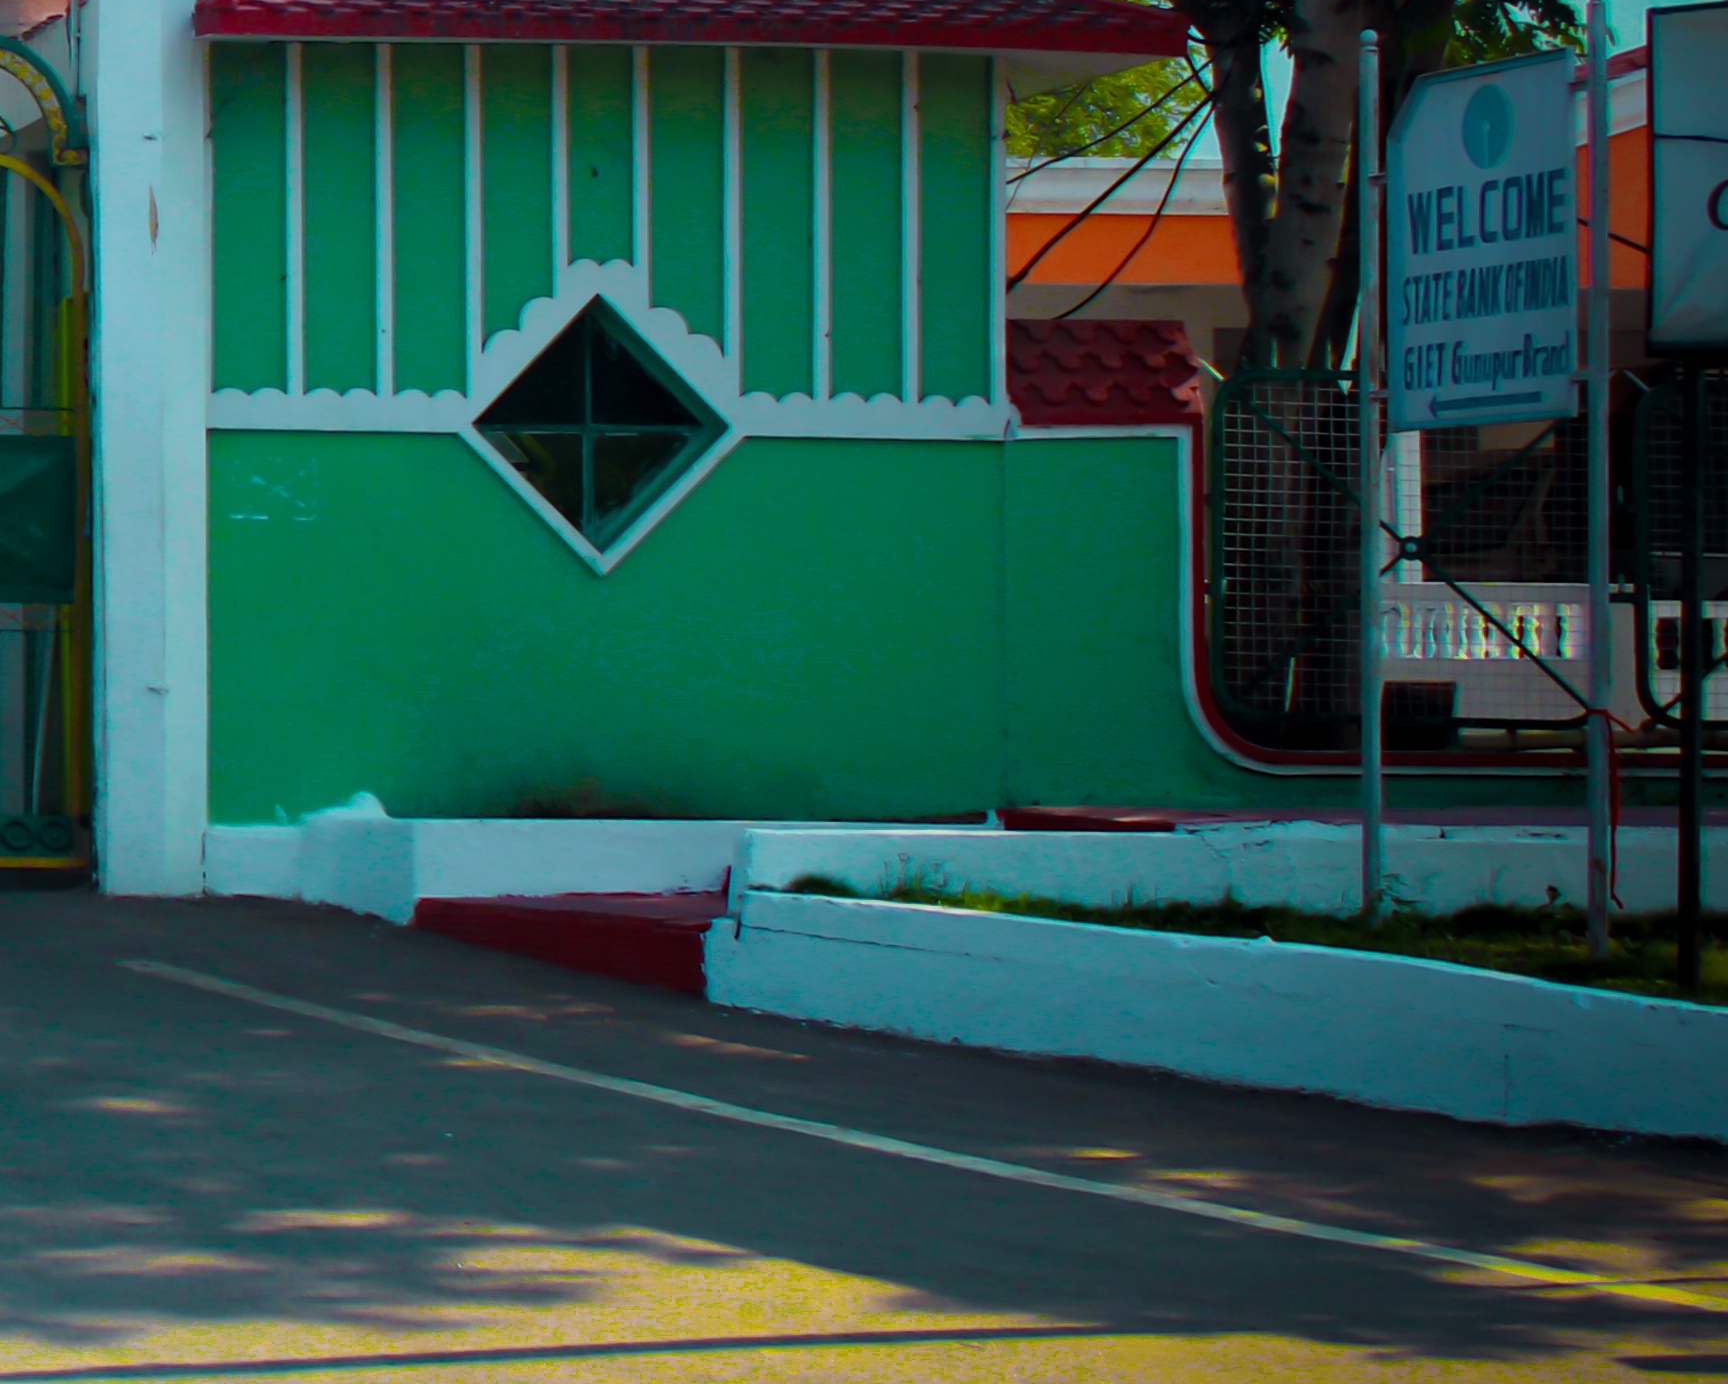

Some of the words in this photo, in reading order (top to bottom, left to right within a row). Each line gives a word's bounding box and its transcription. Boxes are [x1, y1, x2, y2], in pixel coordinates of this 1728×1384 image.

[1408, 168, 1568, 254] WELCOME
[1402, 271, 1455, 325] STATE
[1456, 264, 1505, 319] BANK
[1505, 261, 1523, 313] OF
[1523, 255, 1569, 310] INDIA
[1404, 343, 1448, 390] GIET
[1452, 340, 1523, 390] Gunupur
